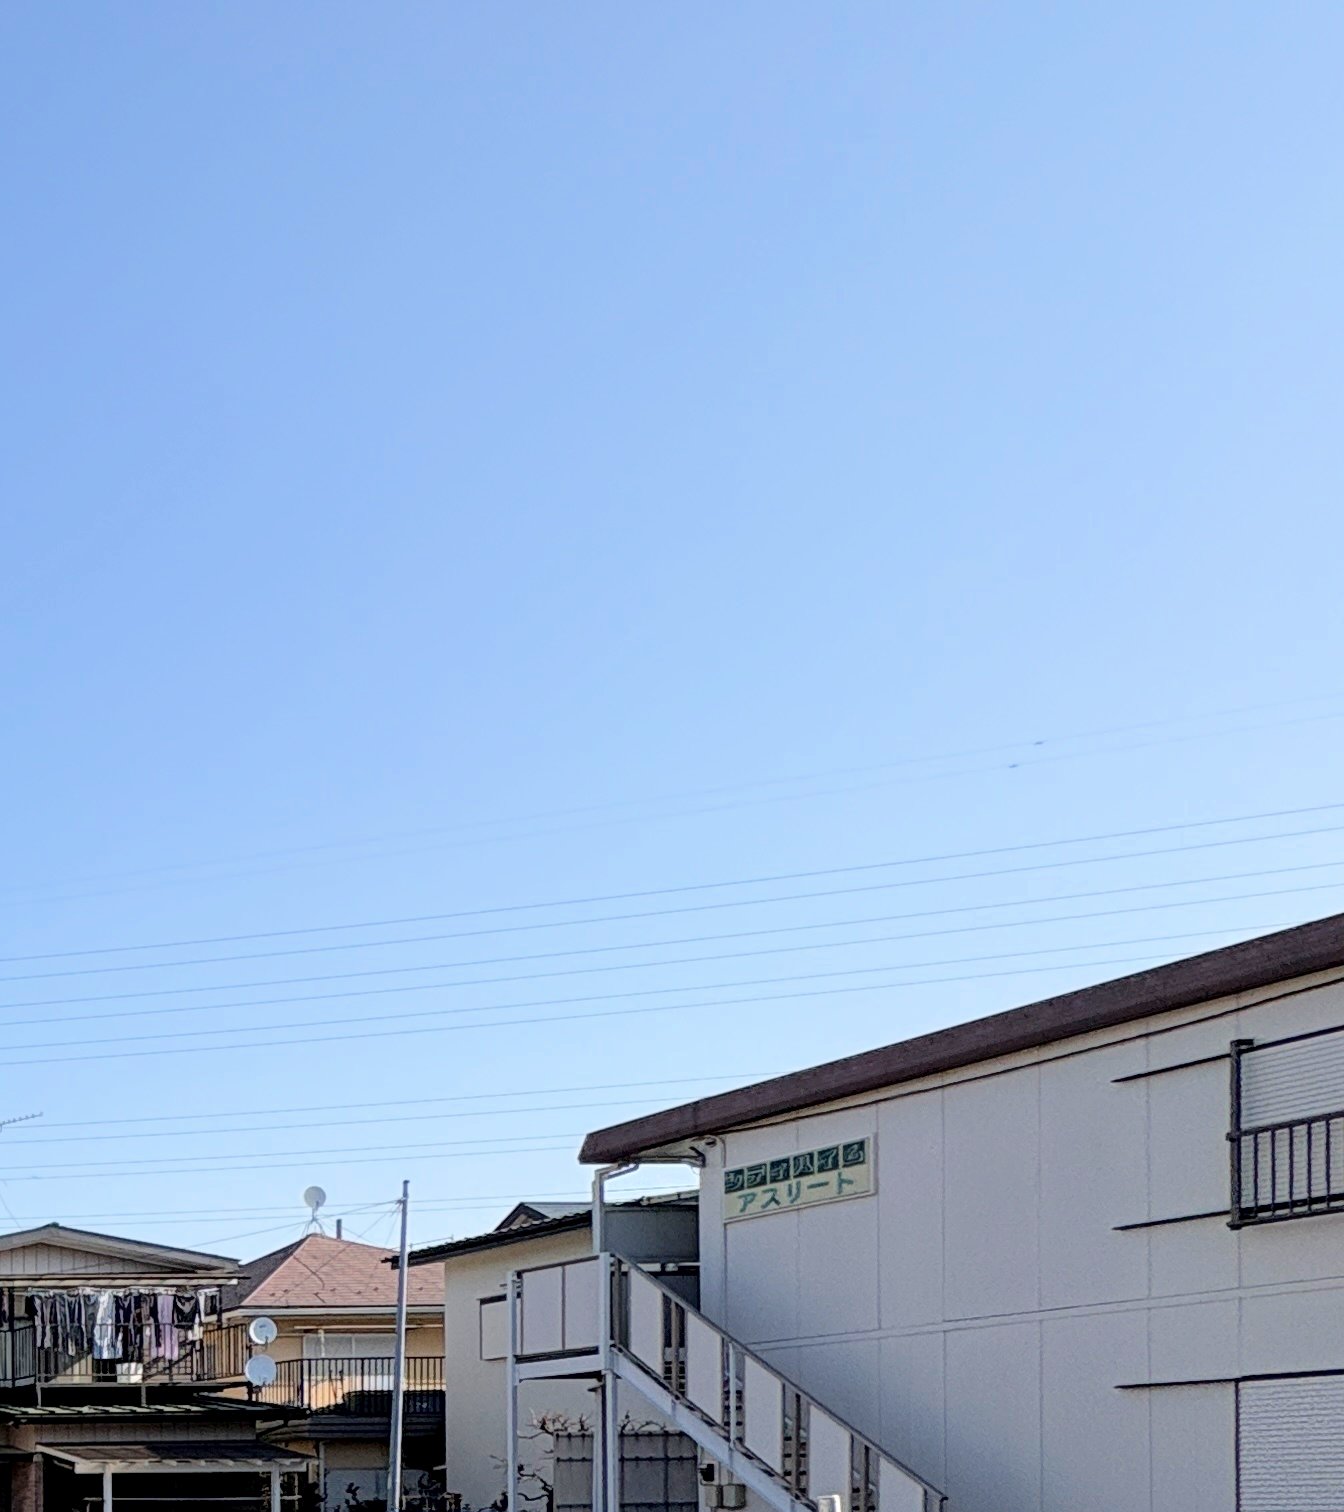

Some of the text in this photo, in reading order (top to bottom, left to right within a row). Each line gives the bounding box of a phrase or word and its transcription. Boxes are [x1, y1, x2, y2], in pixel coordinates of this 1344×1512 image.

[737, 1171, 855, 1213] アスリート
